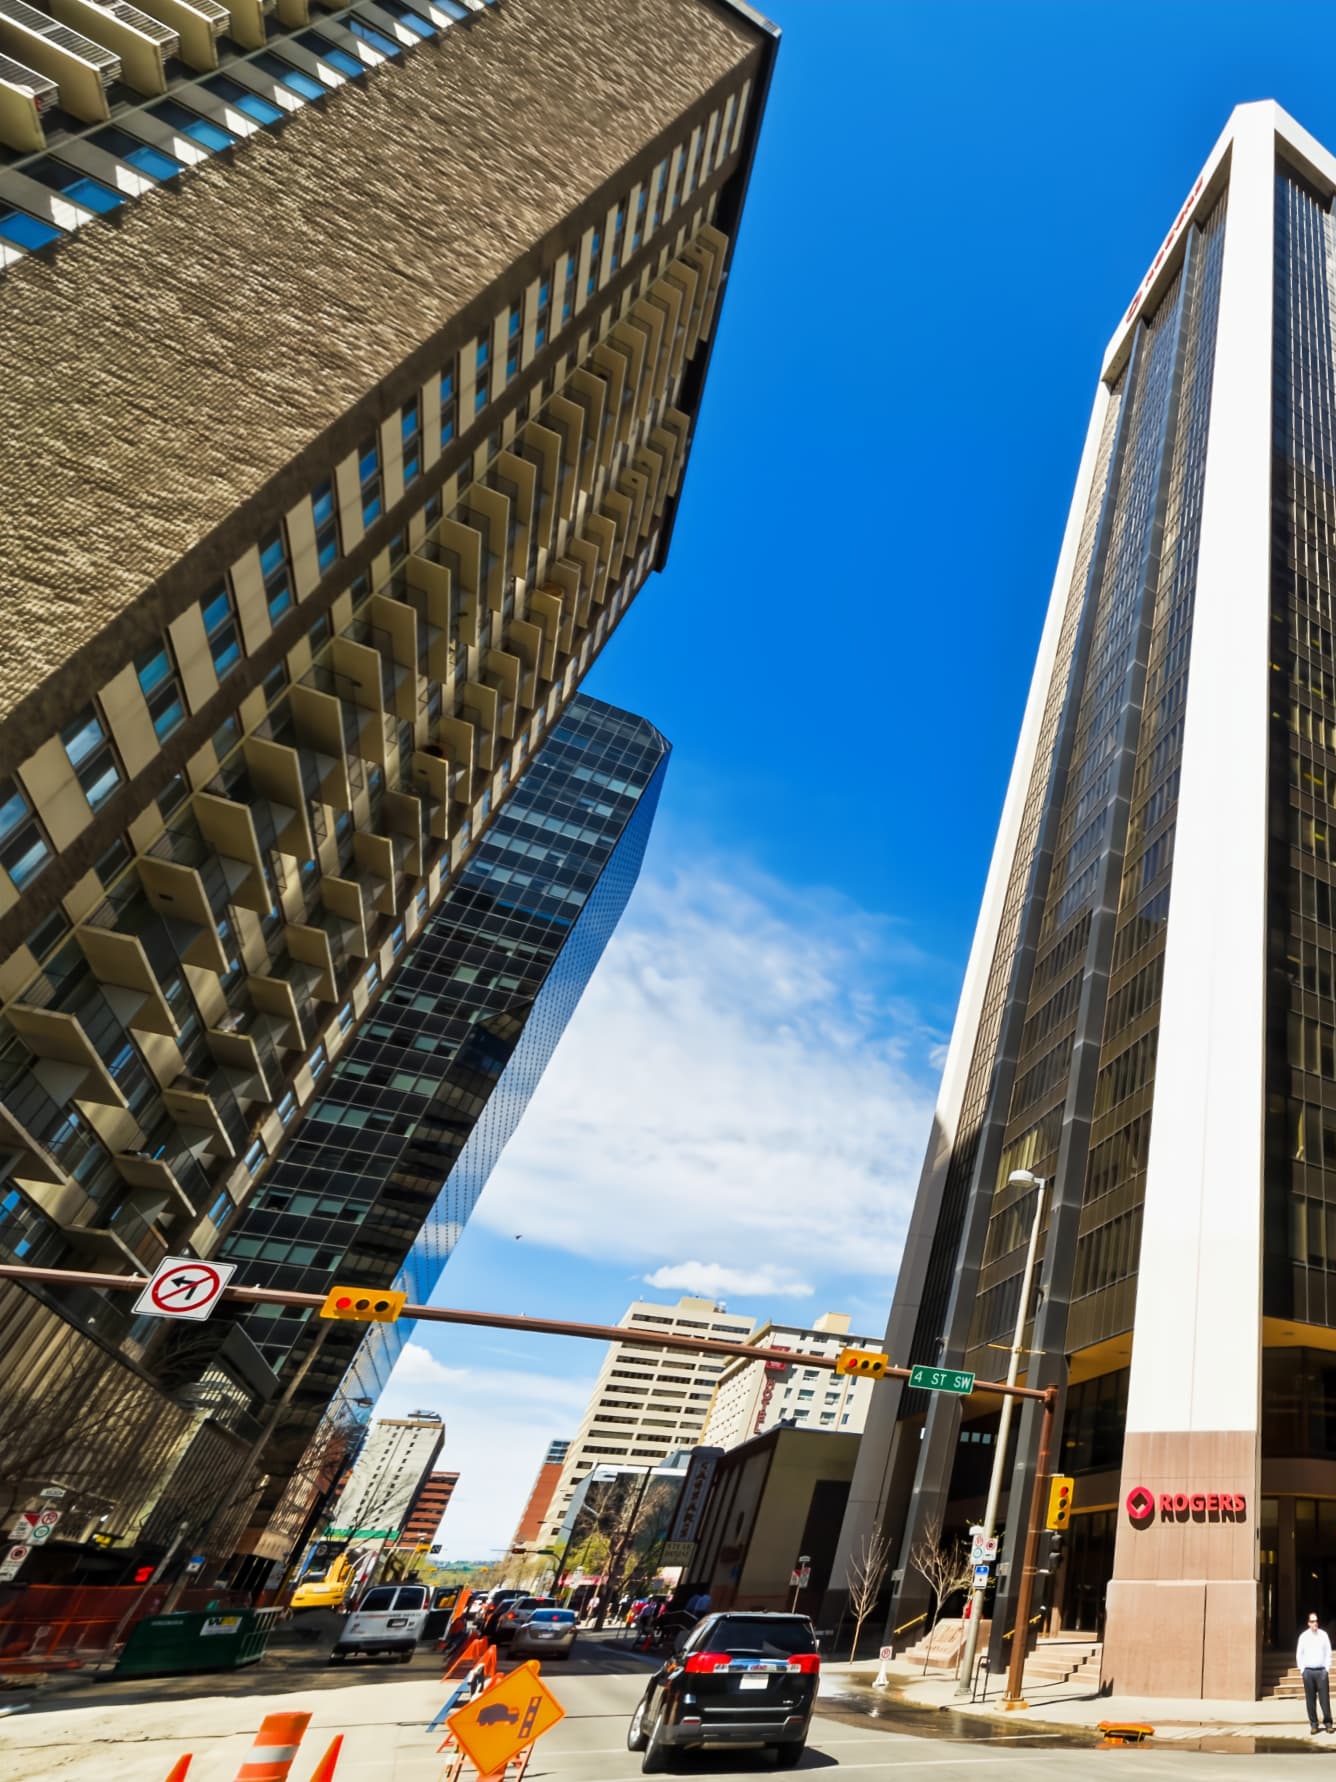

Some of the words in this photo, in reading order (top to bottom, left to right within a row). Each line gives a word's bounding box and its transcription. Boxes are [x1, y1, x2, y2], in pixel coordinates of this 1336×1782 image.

[914, 1370, 923, 1383] 4
[930, 1372, 947, 1386] ST
[953, 1375, 971, 1390] SW
[1158, 1493, 1245, 1512] ROGERS
